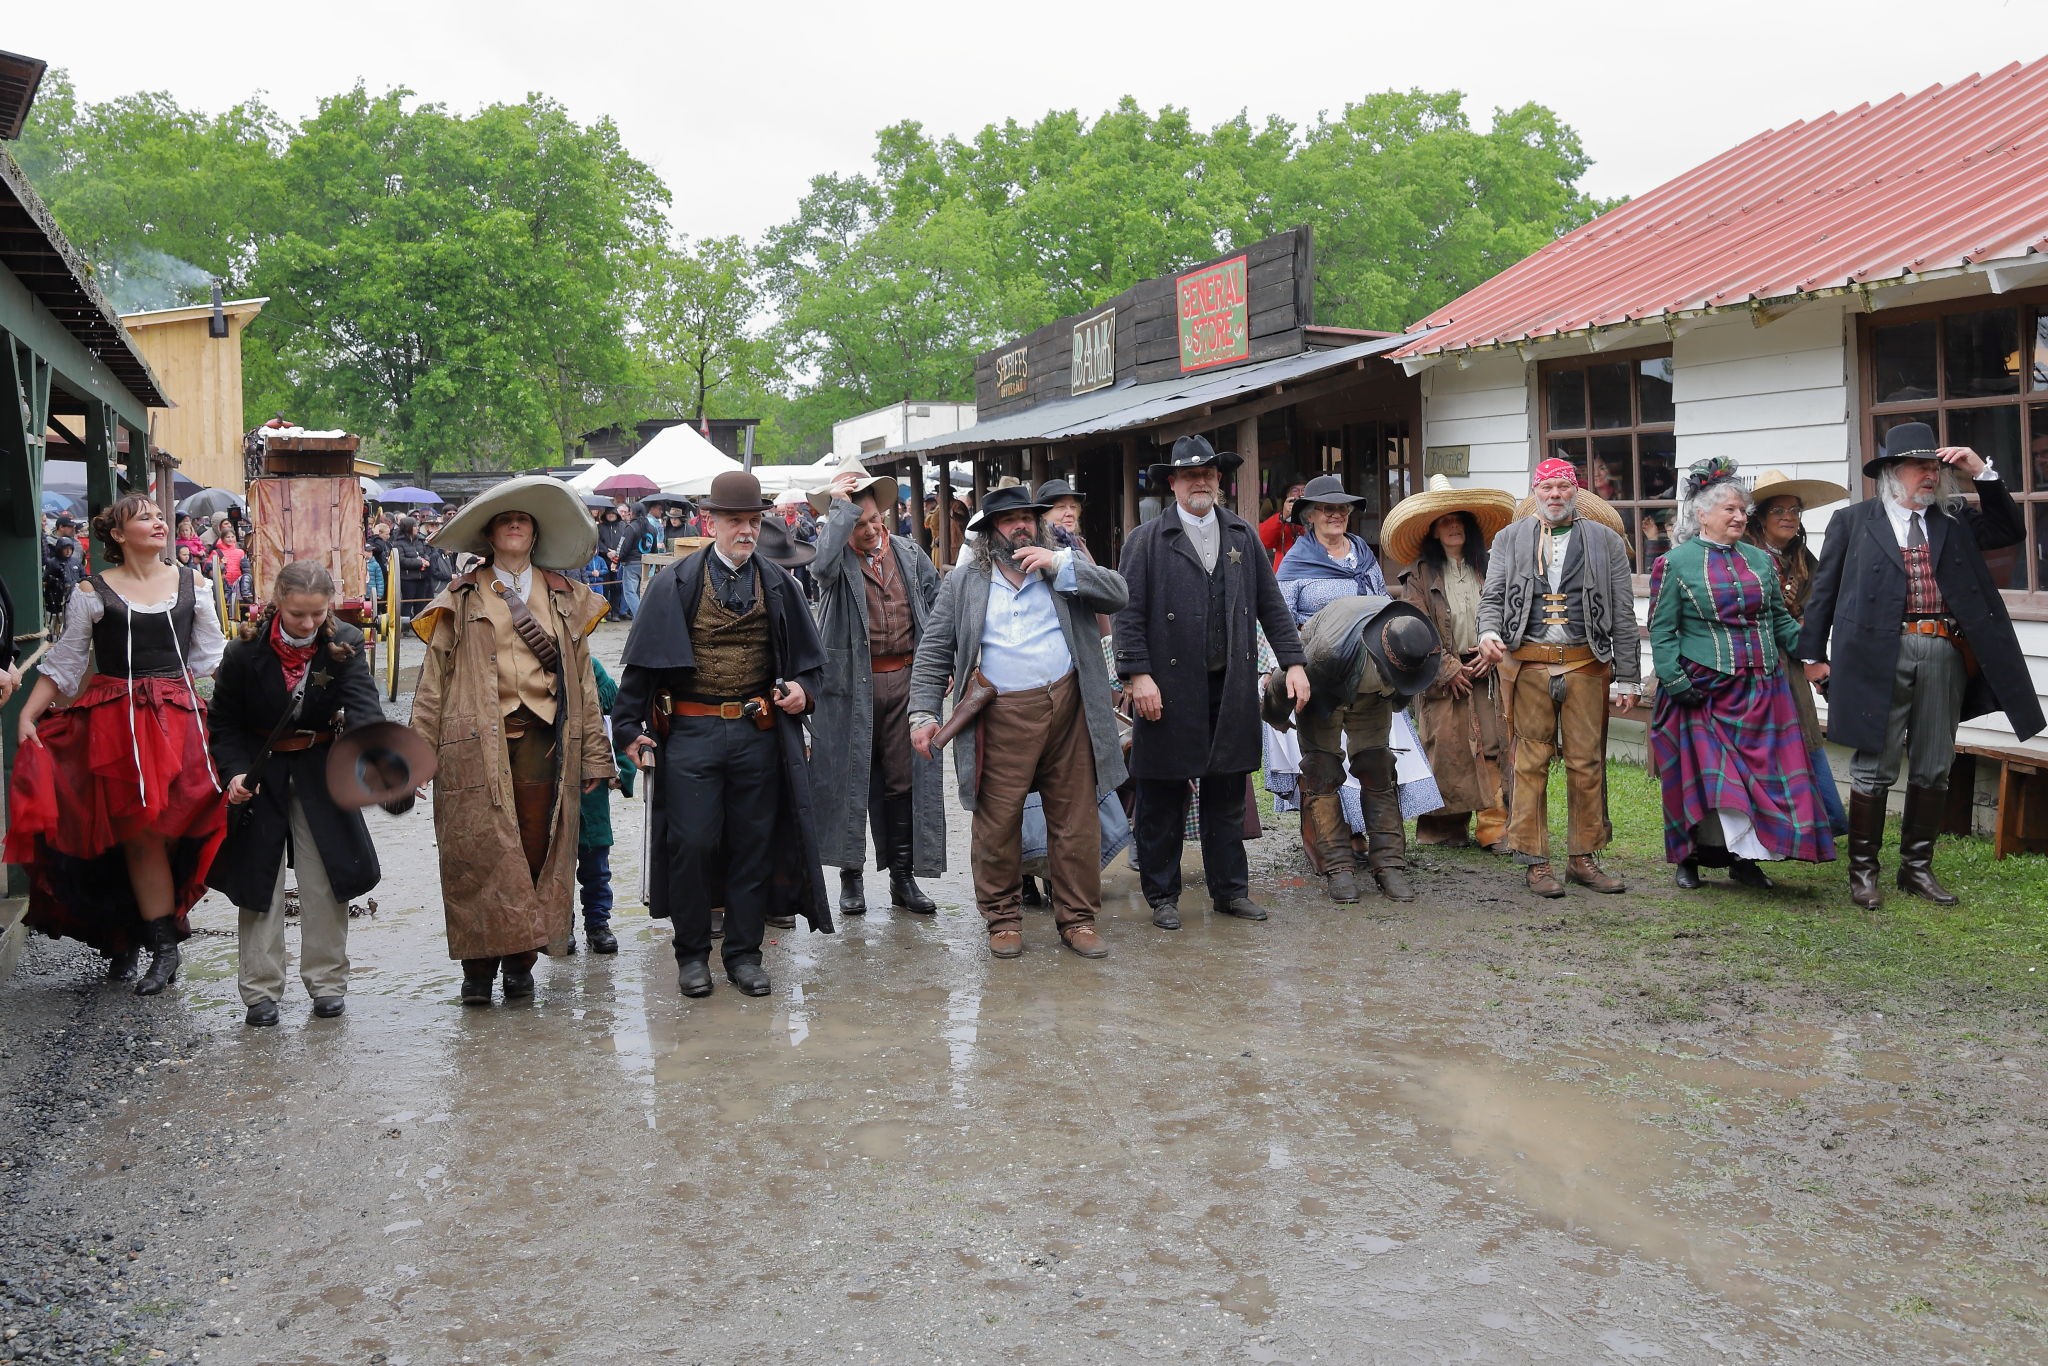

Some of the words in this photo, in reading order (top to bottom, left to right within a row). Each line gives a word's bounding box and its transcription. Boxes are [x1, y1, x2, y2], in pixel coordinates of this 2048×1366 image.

[1182, 268, 1244, 320] GENERAL
[1073, 317, 1113, 388] BANK
[1191, 310, 1235, 355] STORE
